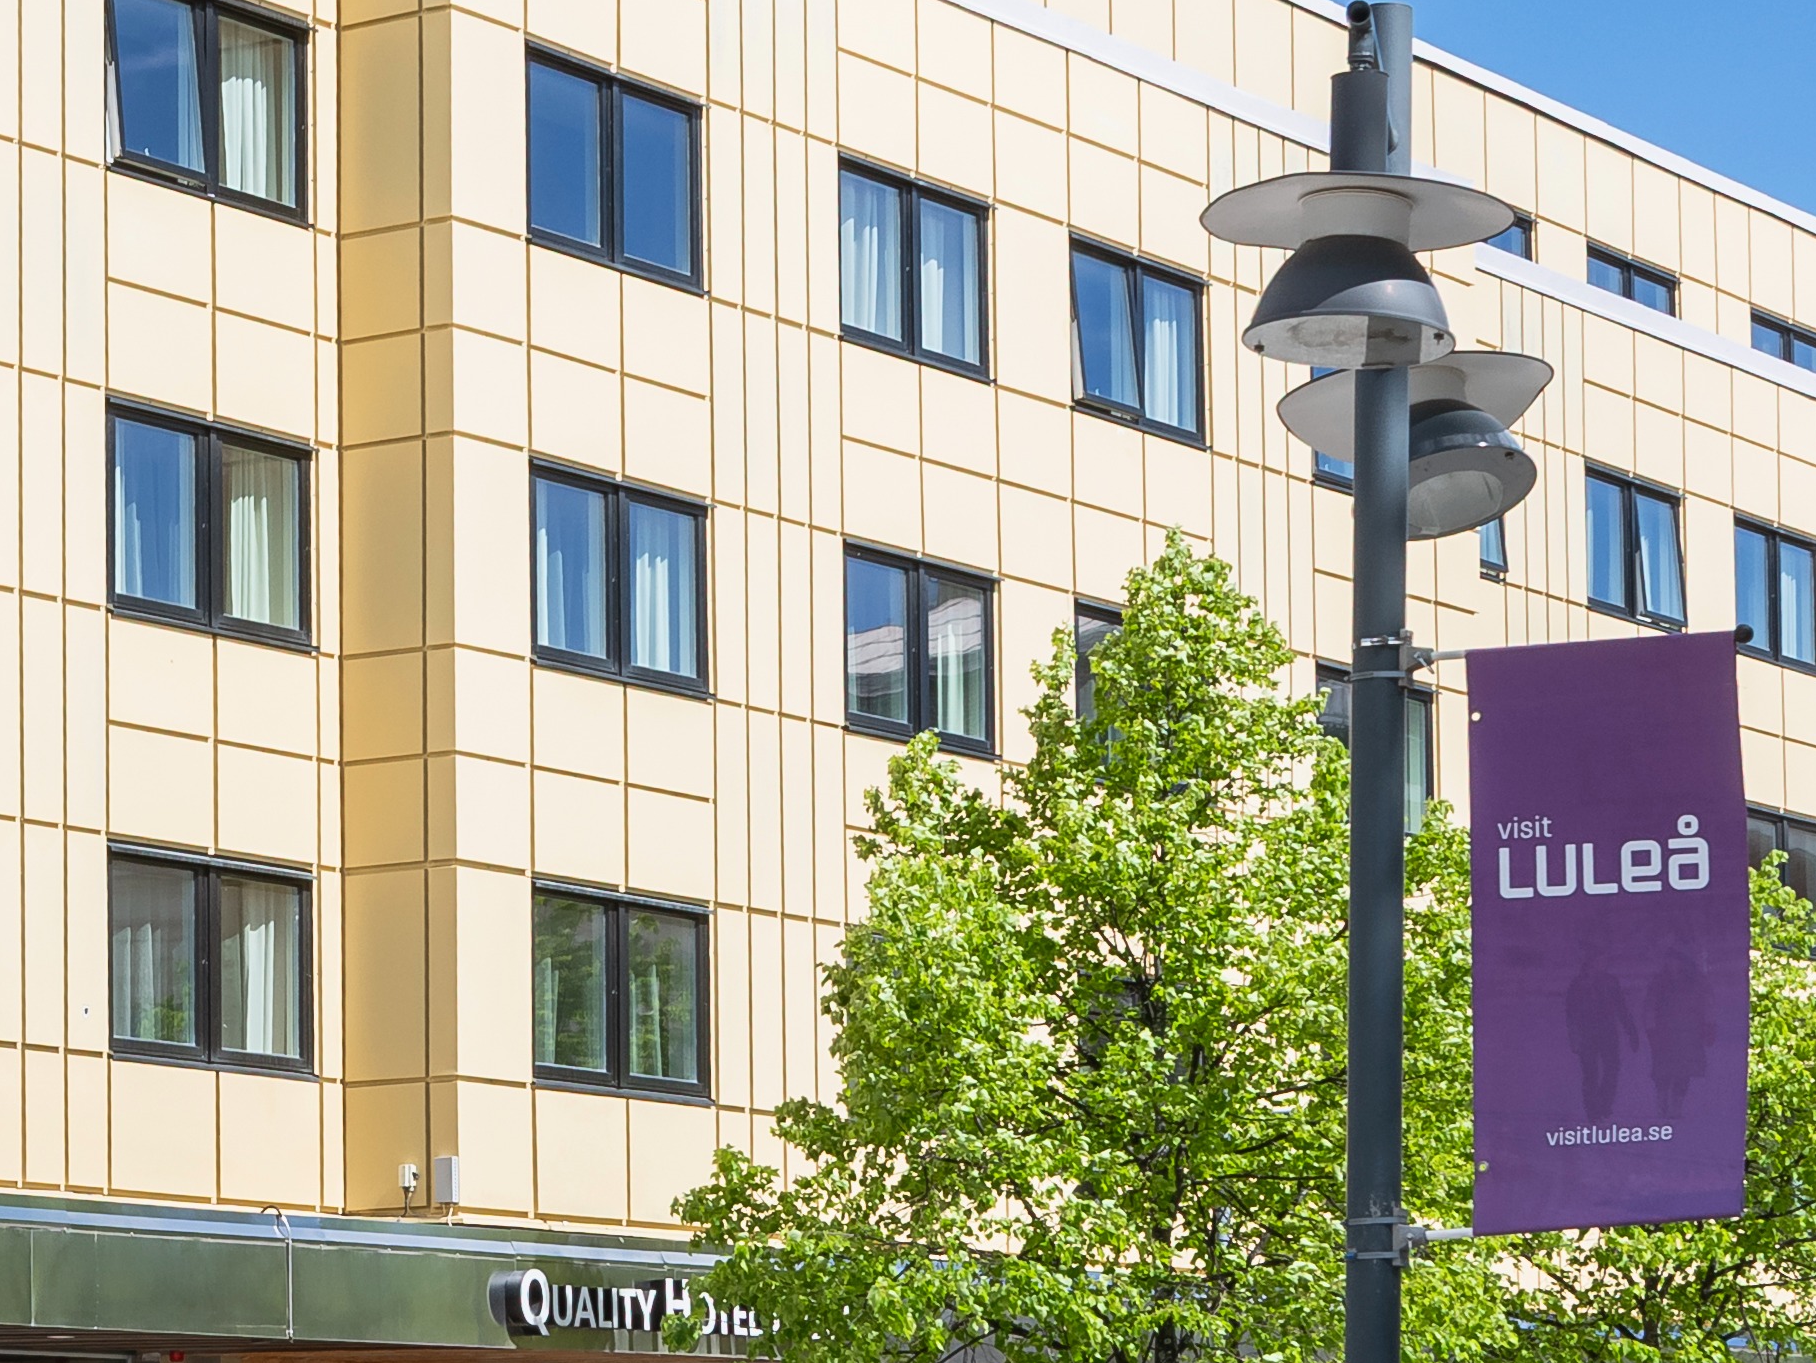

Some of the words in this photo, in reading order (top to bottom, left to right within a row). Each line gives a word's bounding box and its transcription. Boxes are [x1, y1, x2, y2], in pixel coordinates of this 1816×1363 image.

[1497, 816, 1552, 840] visit
[1546, 1123, 1673, 1147] visitlulea.se
[520, 1268, 656, 1336] QUALITY
